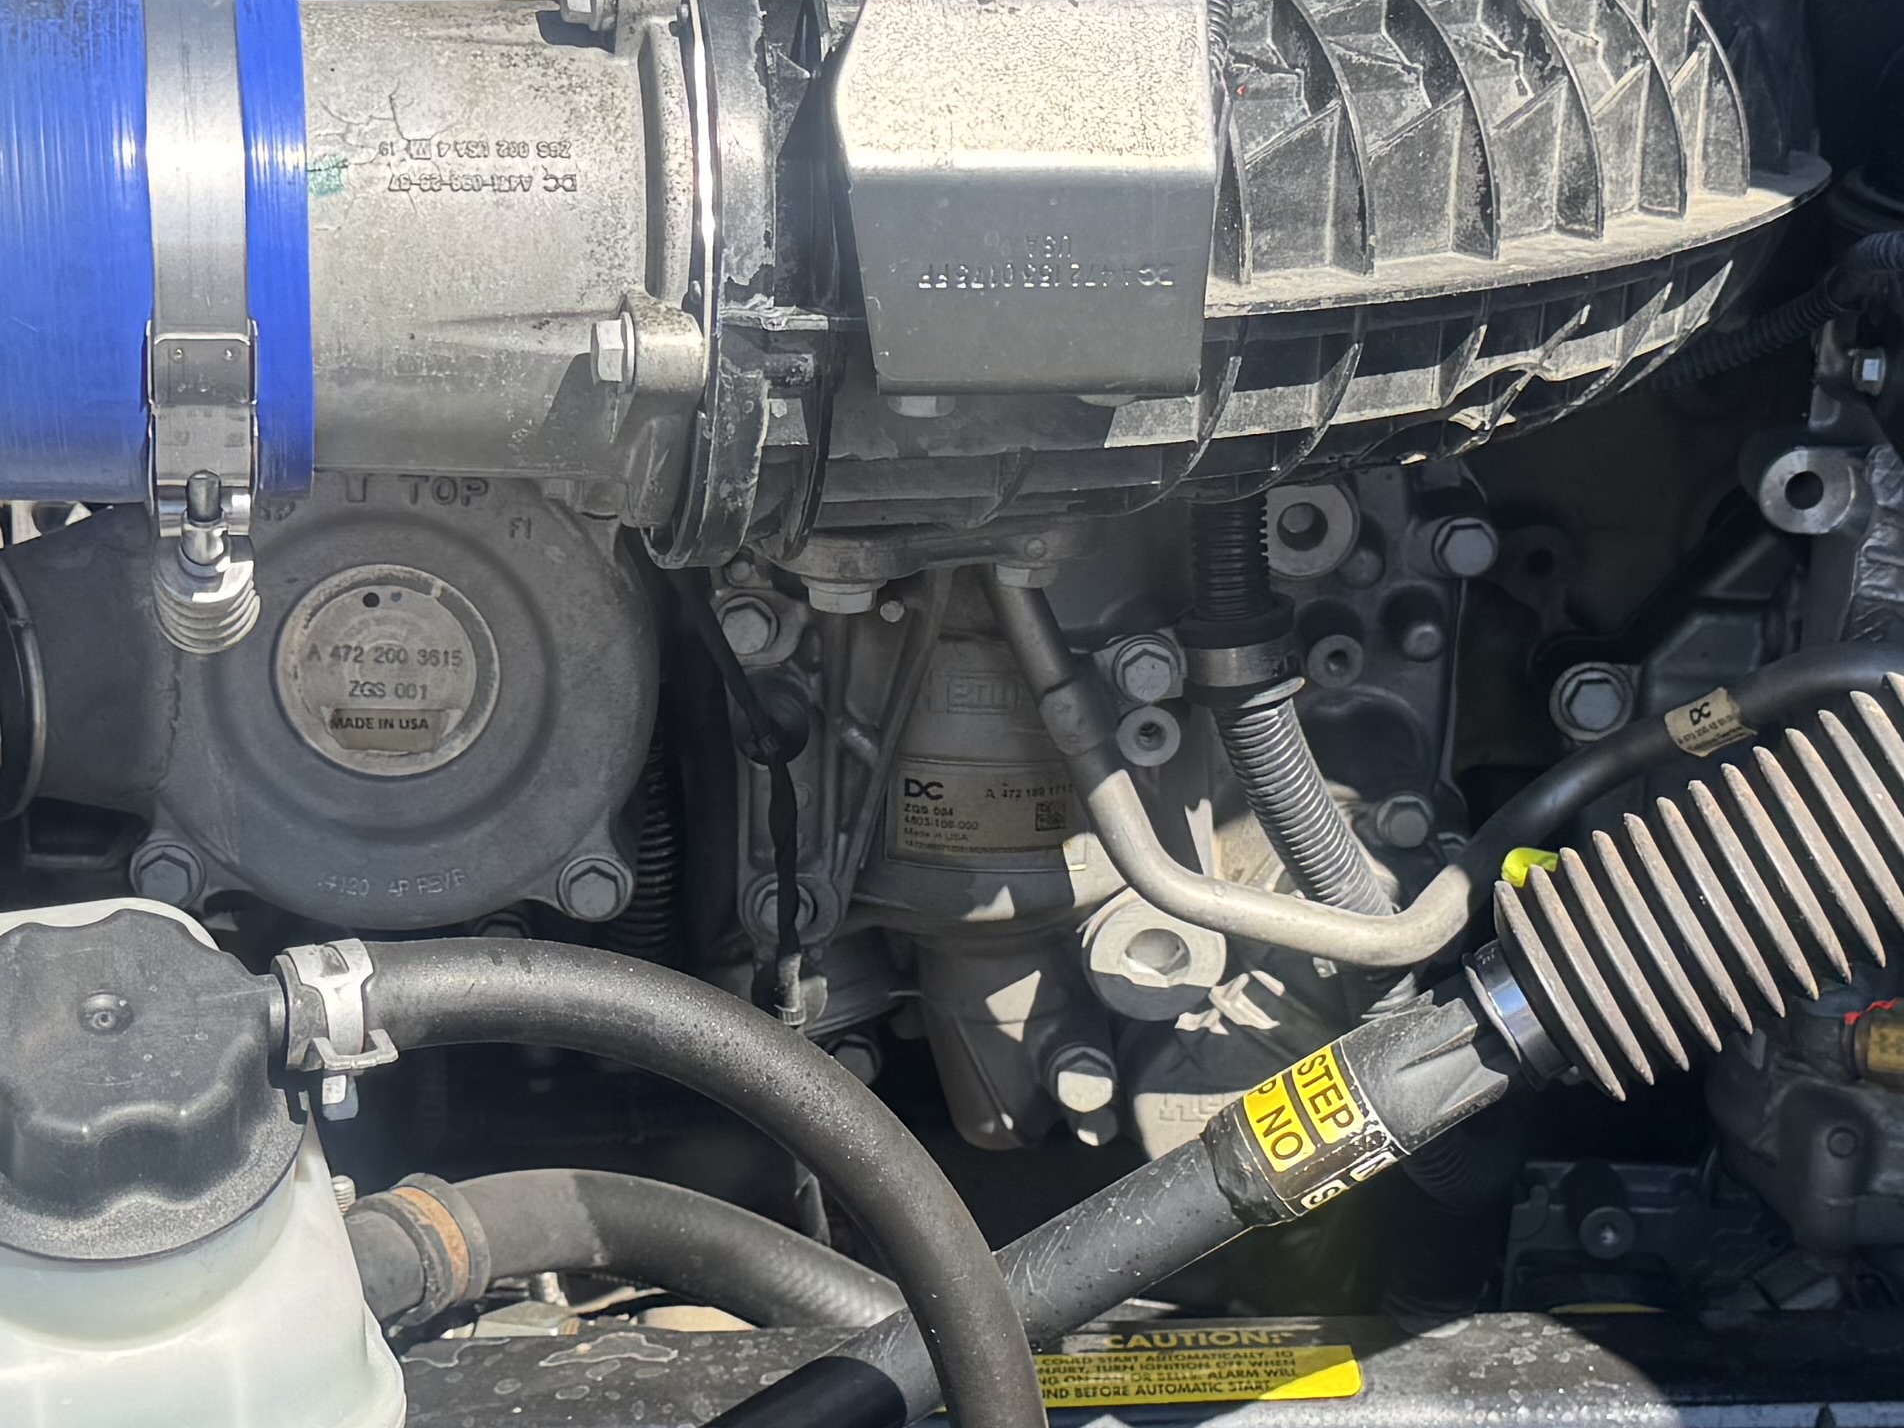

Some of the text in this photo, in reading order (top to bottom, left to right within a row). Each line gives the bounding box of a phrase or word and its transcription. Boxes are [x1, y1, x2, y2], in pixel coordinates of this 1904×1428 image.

[542, 173, 576, 192] DC
[1023, 234, 1071, 258] USA
[398, 474, 489, 506] TOP
[308, 644, 463, 667] A 472 200 3615
[349, 681, 427, 699] ZGS 001
[330, 717, 429, 730] MADE IN USA
[1690, 702, 1711, 725] DC
[904, 777, 944, 800] DC
[984, 789, 996, 798] A
[1297, 1054, 1356, 1130] STEP
[1256, 1110, 1305, 1162] NO
[1042, 1357, 1092, 1365] COULD
[1097, 1355, 1138, 1364] START
[1276, 1350, 1293, 1358] TO
[1097, 1359, 1296, 1372] TURN IGNITION OFF WHEN
[1131, 1374, 1151, 1382] OR
[1208, 1369, 1259, 1379] ALARM
[1267, 1368, 1295, 1377] WILL
[1076, 1386, 1128, 1398] BEFORE
[1136, 1383, 1222, 1396] AUTOMATIC
